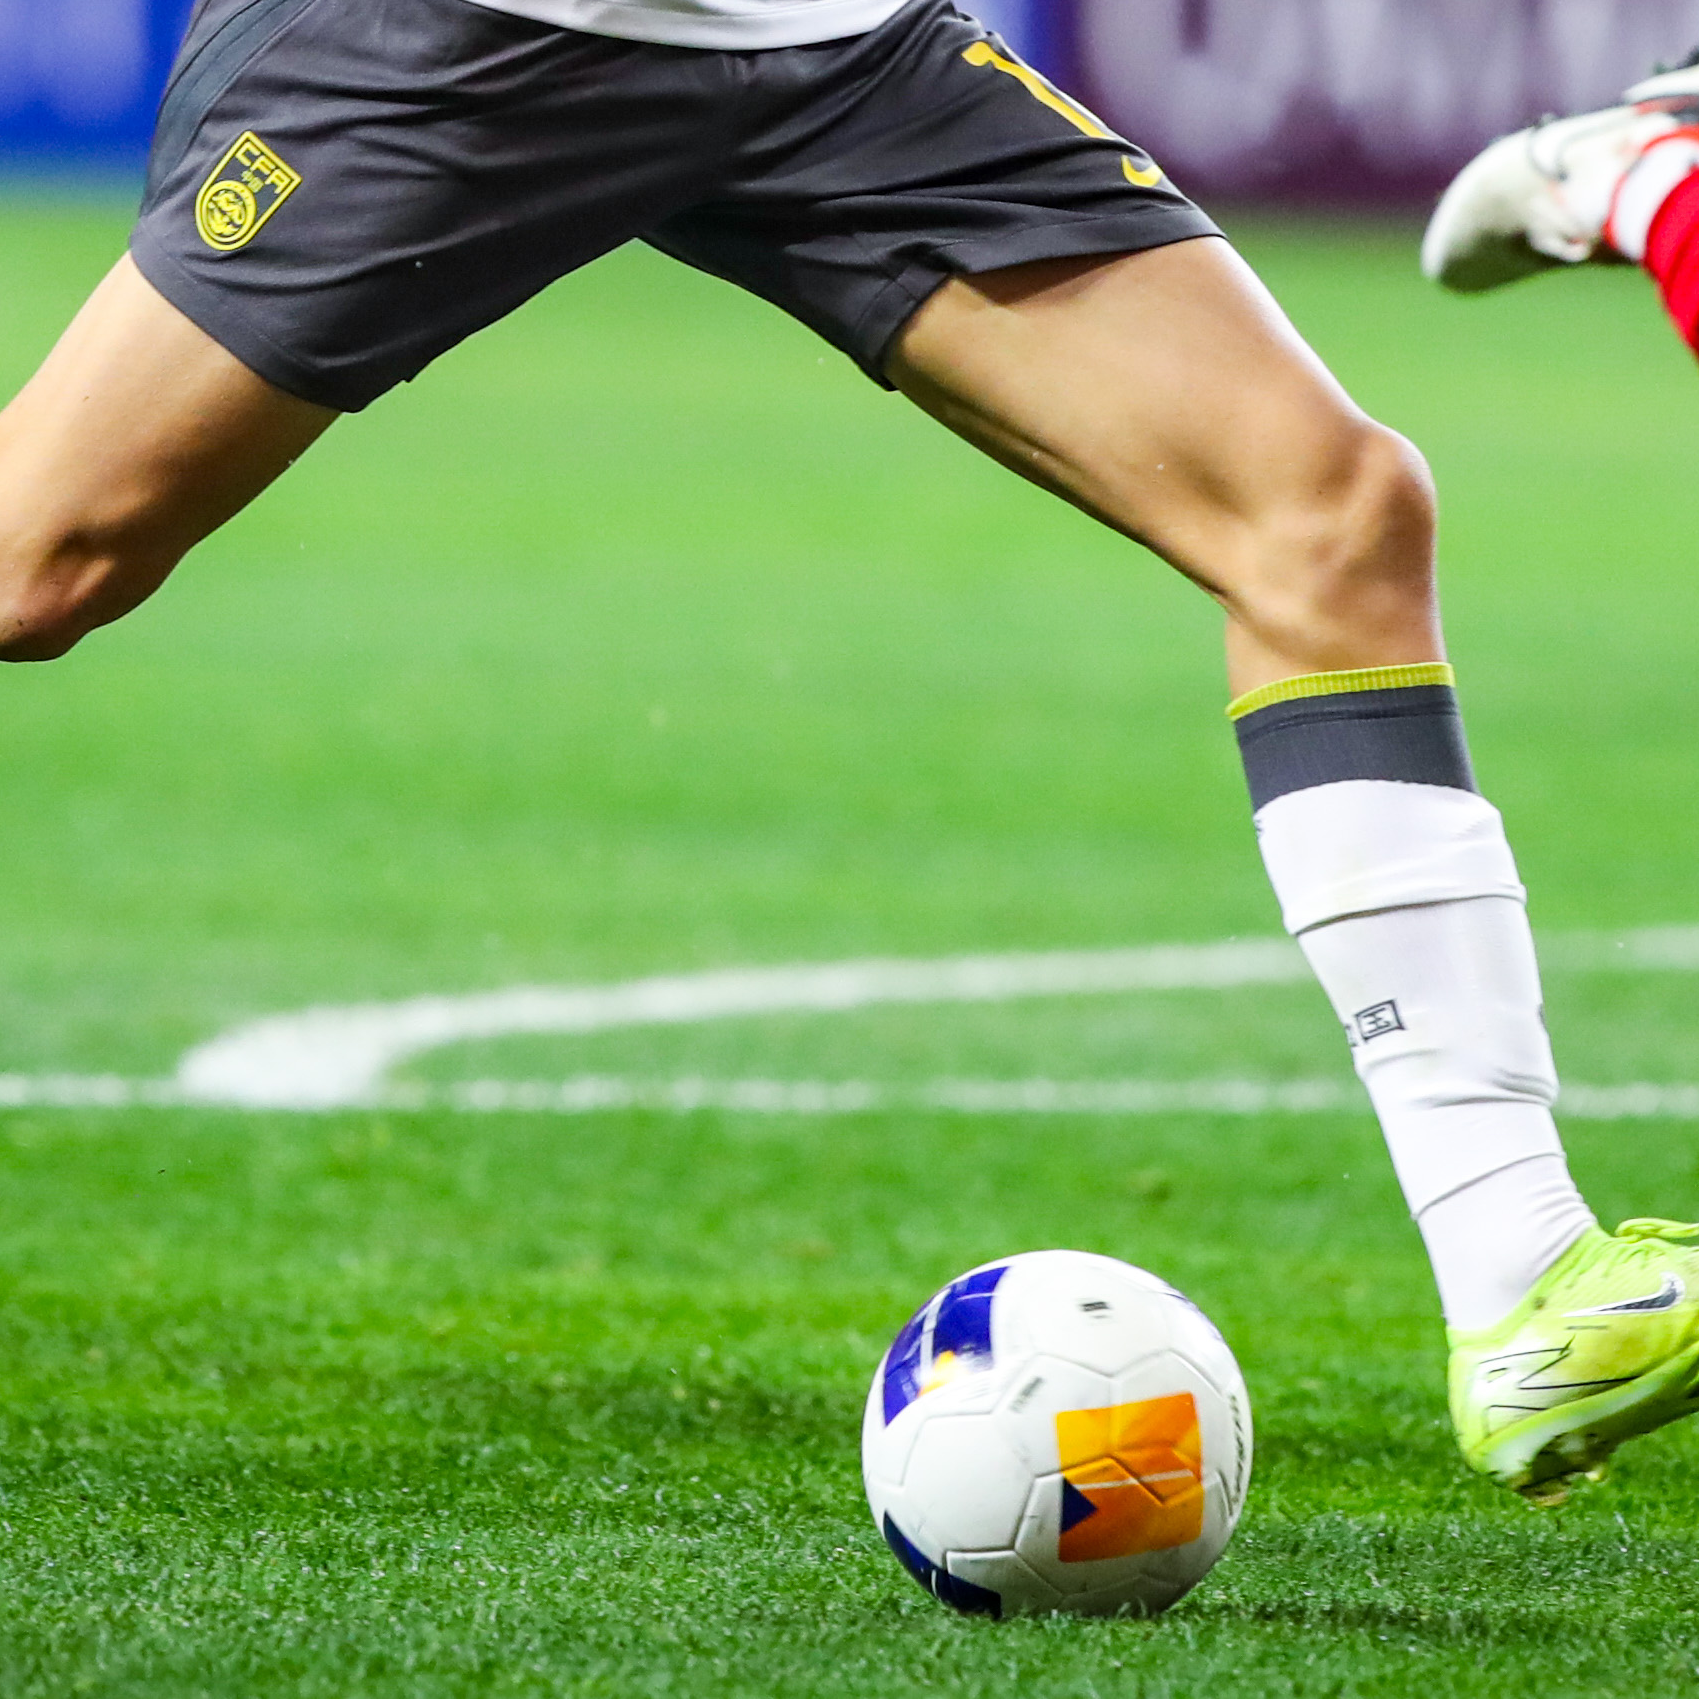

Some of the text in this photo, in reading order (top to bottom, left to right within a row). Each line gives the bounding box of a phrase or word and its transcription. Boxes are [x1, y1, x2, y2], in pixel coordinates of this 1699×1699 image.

[961, 41, 1114, 140] 1
[235, 141, 292, 194] CFA
[1345, 999, 1406, 1047] 国
